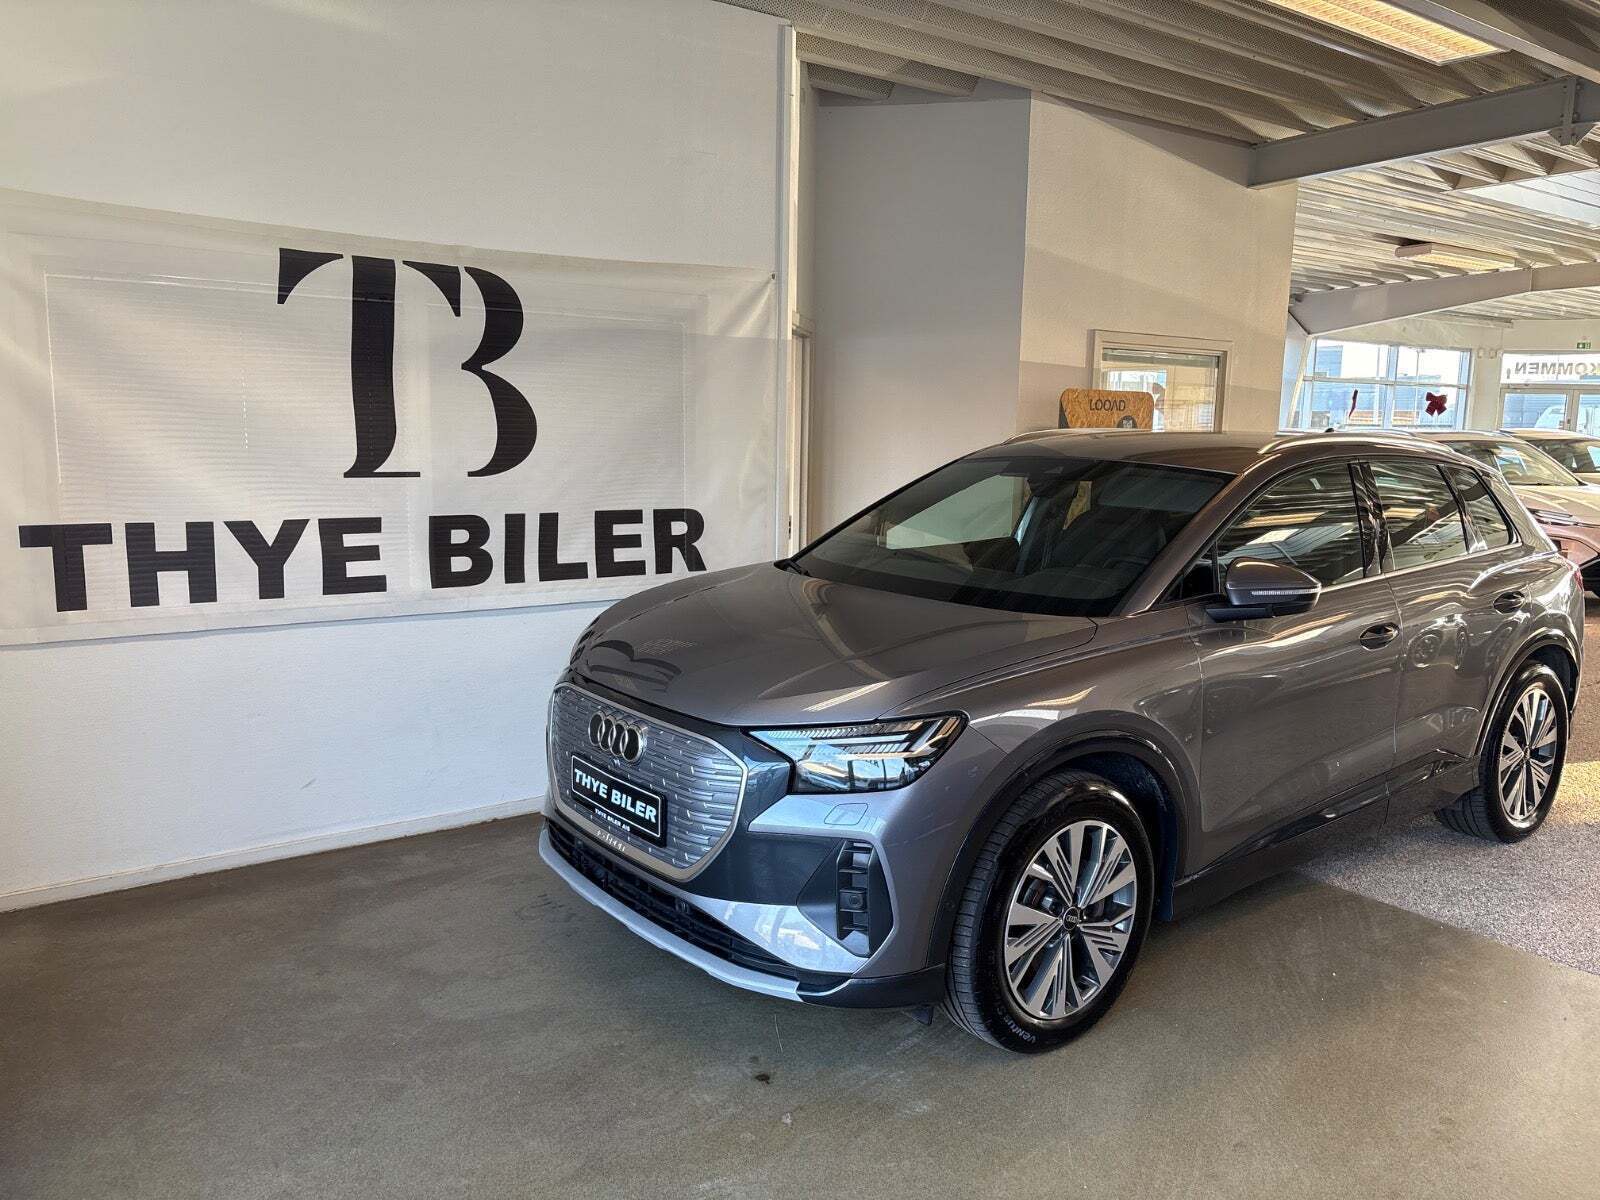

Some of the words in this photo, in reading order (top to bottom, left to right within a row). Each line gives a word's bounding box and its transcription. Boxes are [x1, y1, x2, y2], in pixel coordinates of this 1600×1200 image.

[19, 516, 387, 612] THYE
[429, 507, 707, 589] BILER
[574, 768, 608, 799] THYE
[611, 788, 657, 823] BILER
